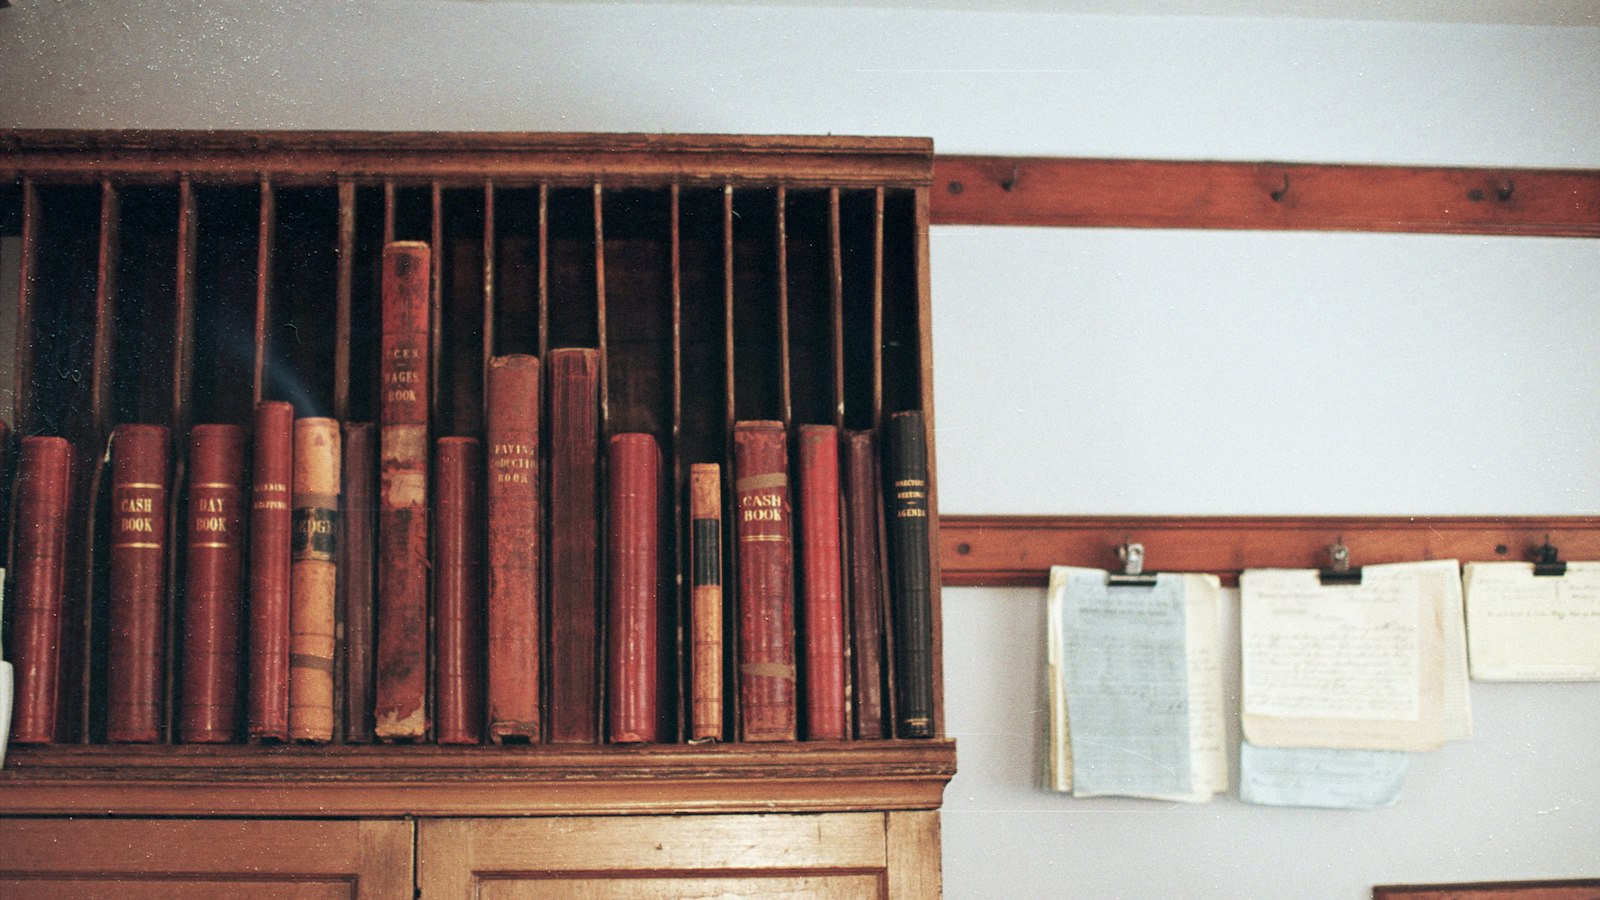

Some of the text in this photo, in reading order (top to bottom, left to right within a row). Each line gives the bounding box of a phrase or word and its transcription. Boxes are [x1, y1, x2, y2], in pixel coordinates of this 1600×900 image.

[388, 390, 416, 402] BOOK
[497, 473, 528, 484] BOOK
[121, 497, 152, 513] CASH
[199, 497, 224, 512] DAY
[742, 494, 782, 507] CASH
[744, 508, 782, 522] BOOK
[897, 508, 926, 517] AGENDA
[121, 517, 153, 532] BOOK
[196, 517, 226, 532] BOOK
